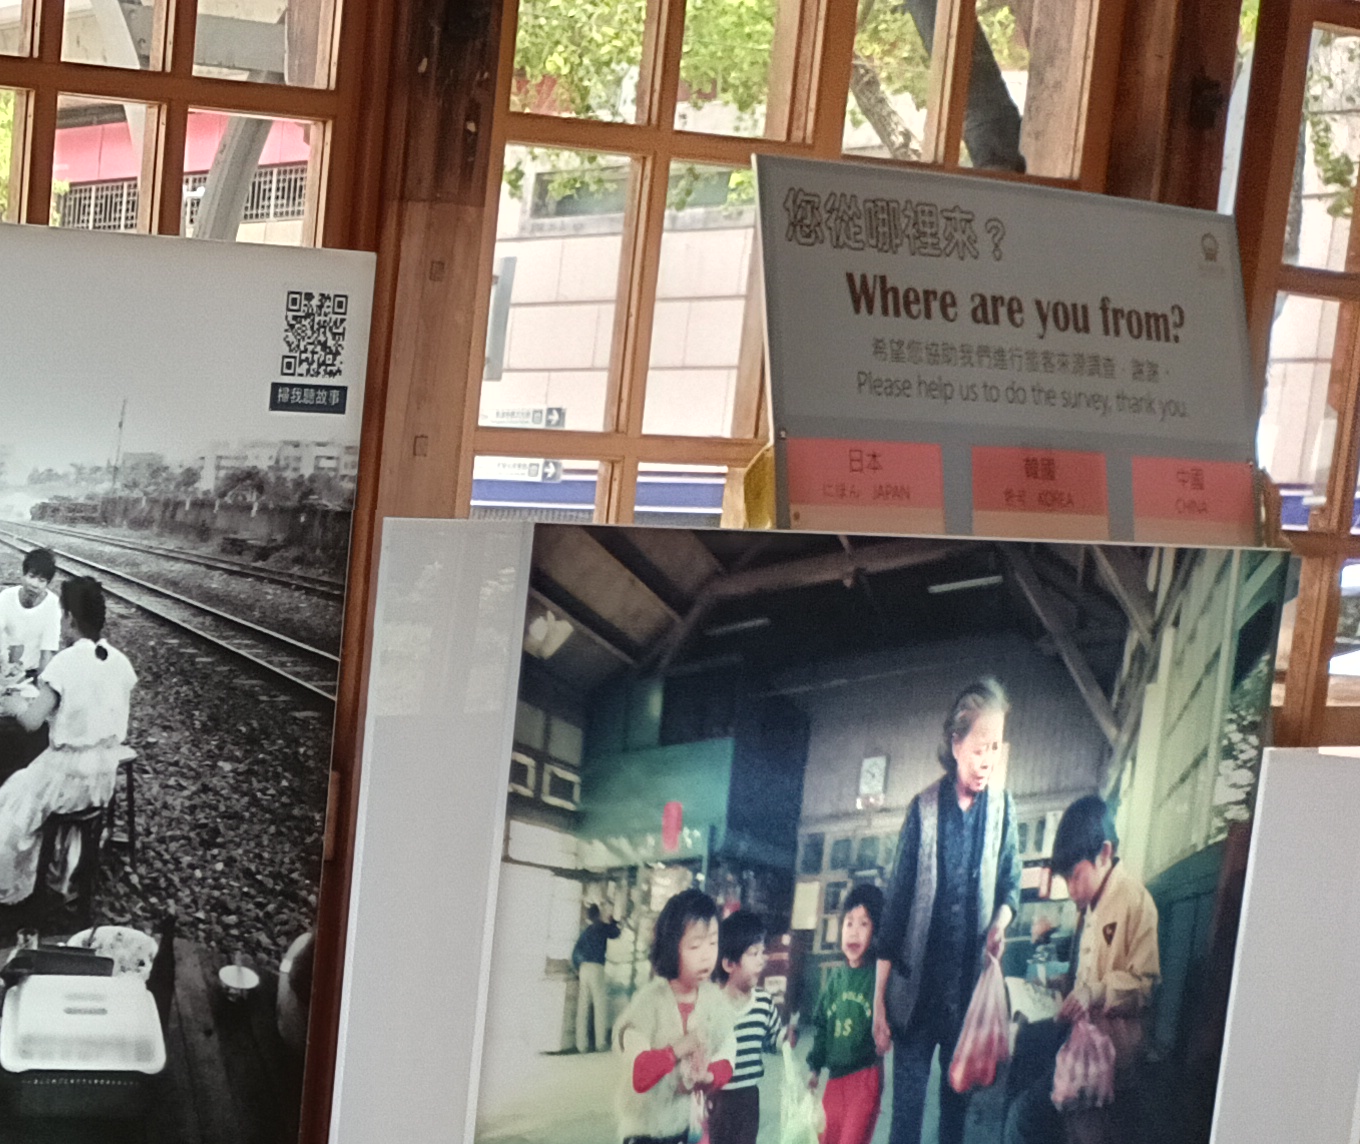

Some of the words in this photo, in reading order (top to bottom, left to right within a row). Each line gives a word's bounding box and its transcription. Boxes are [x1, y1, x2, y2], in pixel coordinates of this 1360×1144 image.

[782, 186, 1007, 262] 您從哪裡來？
[845, 271, 958, 323] Where
[970, 292, 1025, 329] are
[1034, 297, 1091, 340] you
[1099, 295, 1185, 344] from?
[856, 369, 912, 399] Please
[917, 373, 955, 405] help
[959, 382, 978, 402] us
[981, 381, 1001, 403] to
[1004, 380, 1027, 405] do
[1031, 382, 1056, 407] the
[1116, 389, 1157, 415] thank
[849, 449, 883, 473] 日本
[873, 483, 911, 501] JAPAN
